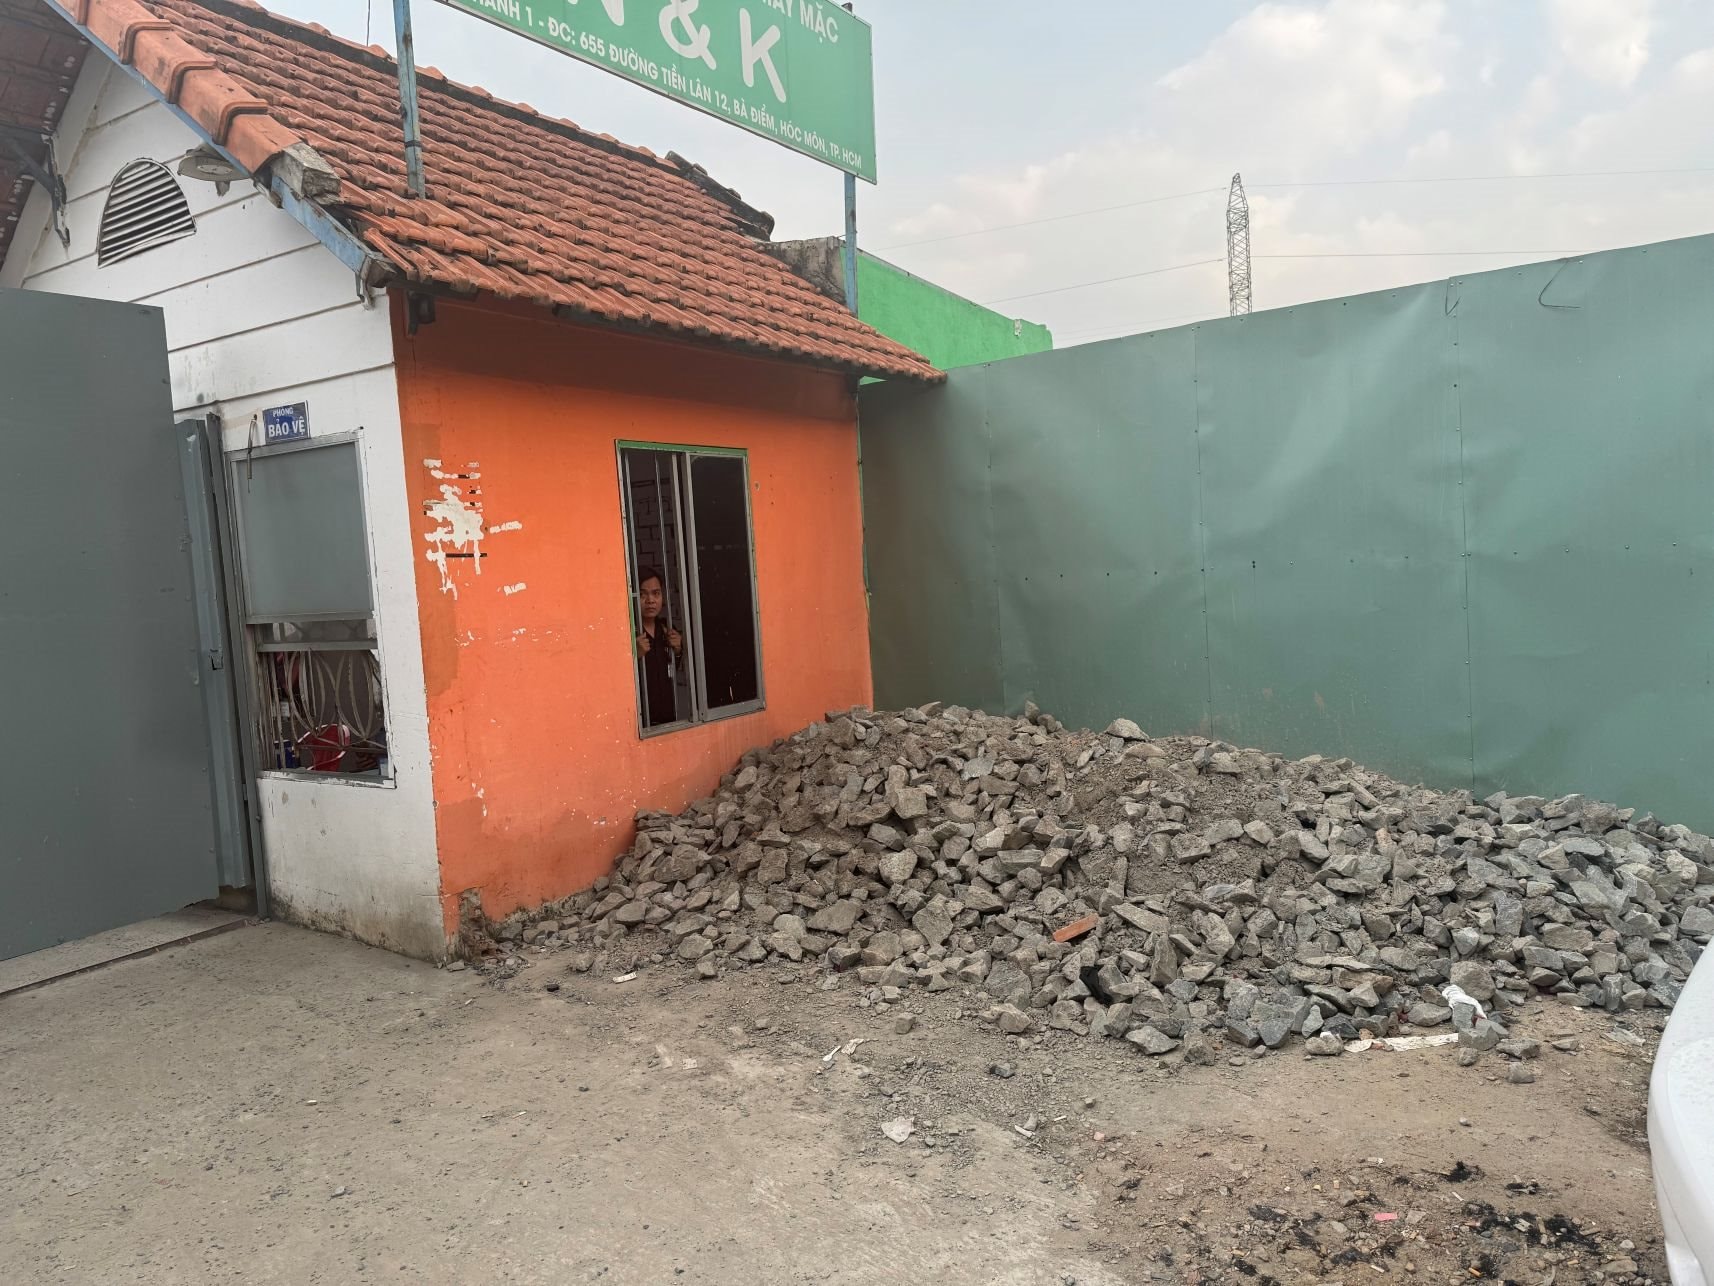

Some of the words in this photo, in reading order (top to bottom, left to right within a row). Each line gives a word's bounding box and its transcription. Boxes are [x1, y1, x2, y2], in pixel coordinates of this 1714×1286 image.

[658, 0, 717, 71] &
[739, 7, 787, 104] K
[799, 0, 839, 44] MẶC
[525, 5, 533, 27] 1
[548, 16, 576, 46] ĐC:
[580, 31, 606, 57] 655
[608, 43, 659, 80] ĐƯỜNG
[660, 63, 687, 94] TIỀN
[689, 77, 712, 104] LÂN
[714, 90, 731, 114] 12,
[733, 97, 749, 120] BÀ
[750, 103, 778, 135] ĐIỂM,
[779, 119, 802, 143] HÓC
[803, 130, 829, 157] MÔN,
[829, 141, 841, 160] TP.
[842, 147, 862, 169] HCM
[268, 418, 290, 437] BẢO
[291, 416, 306, 435] VỆ
